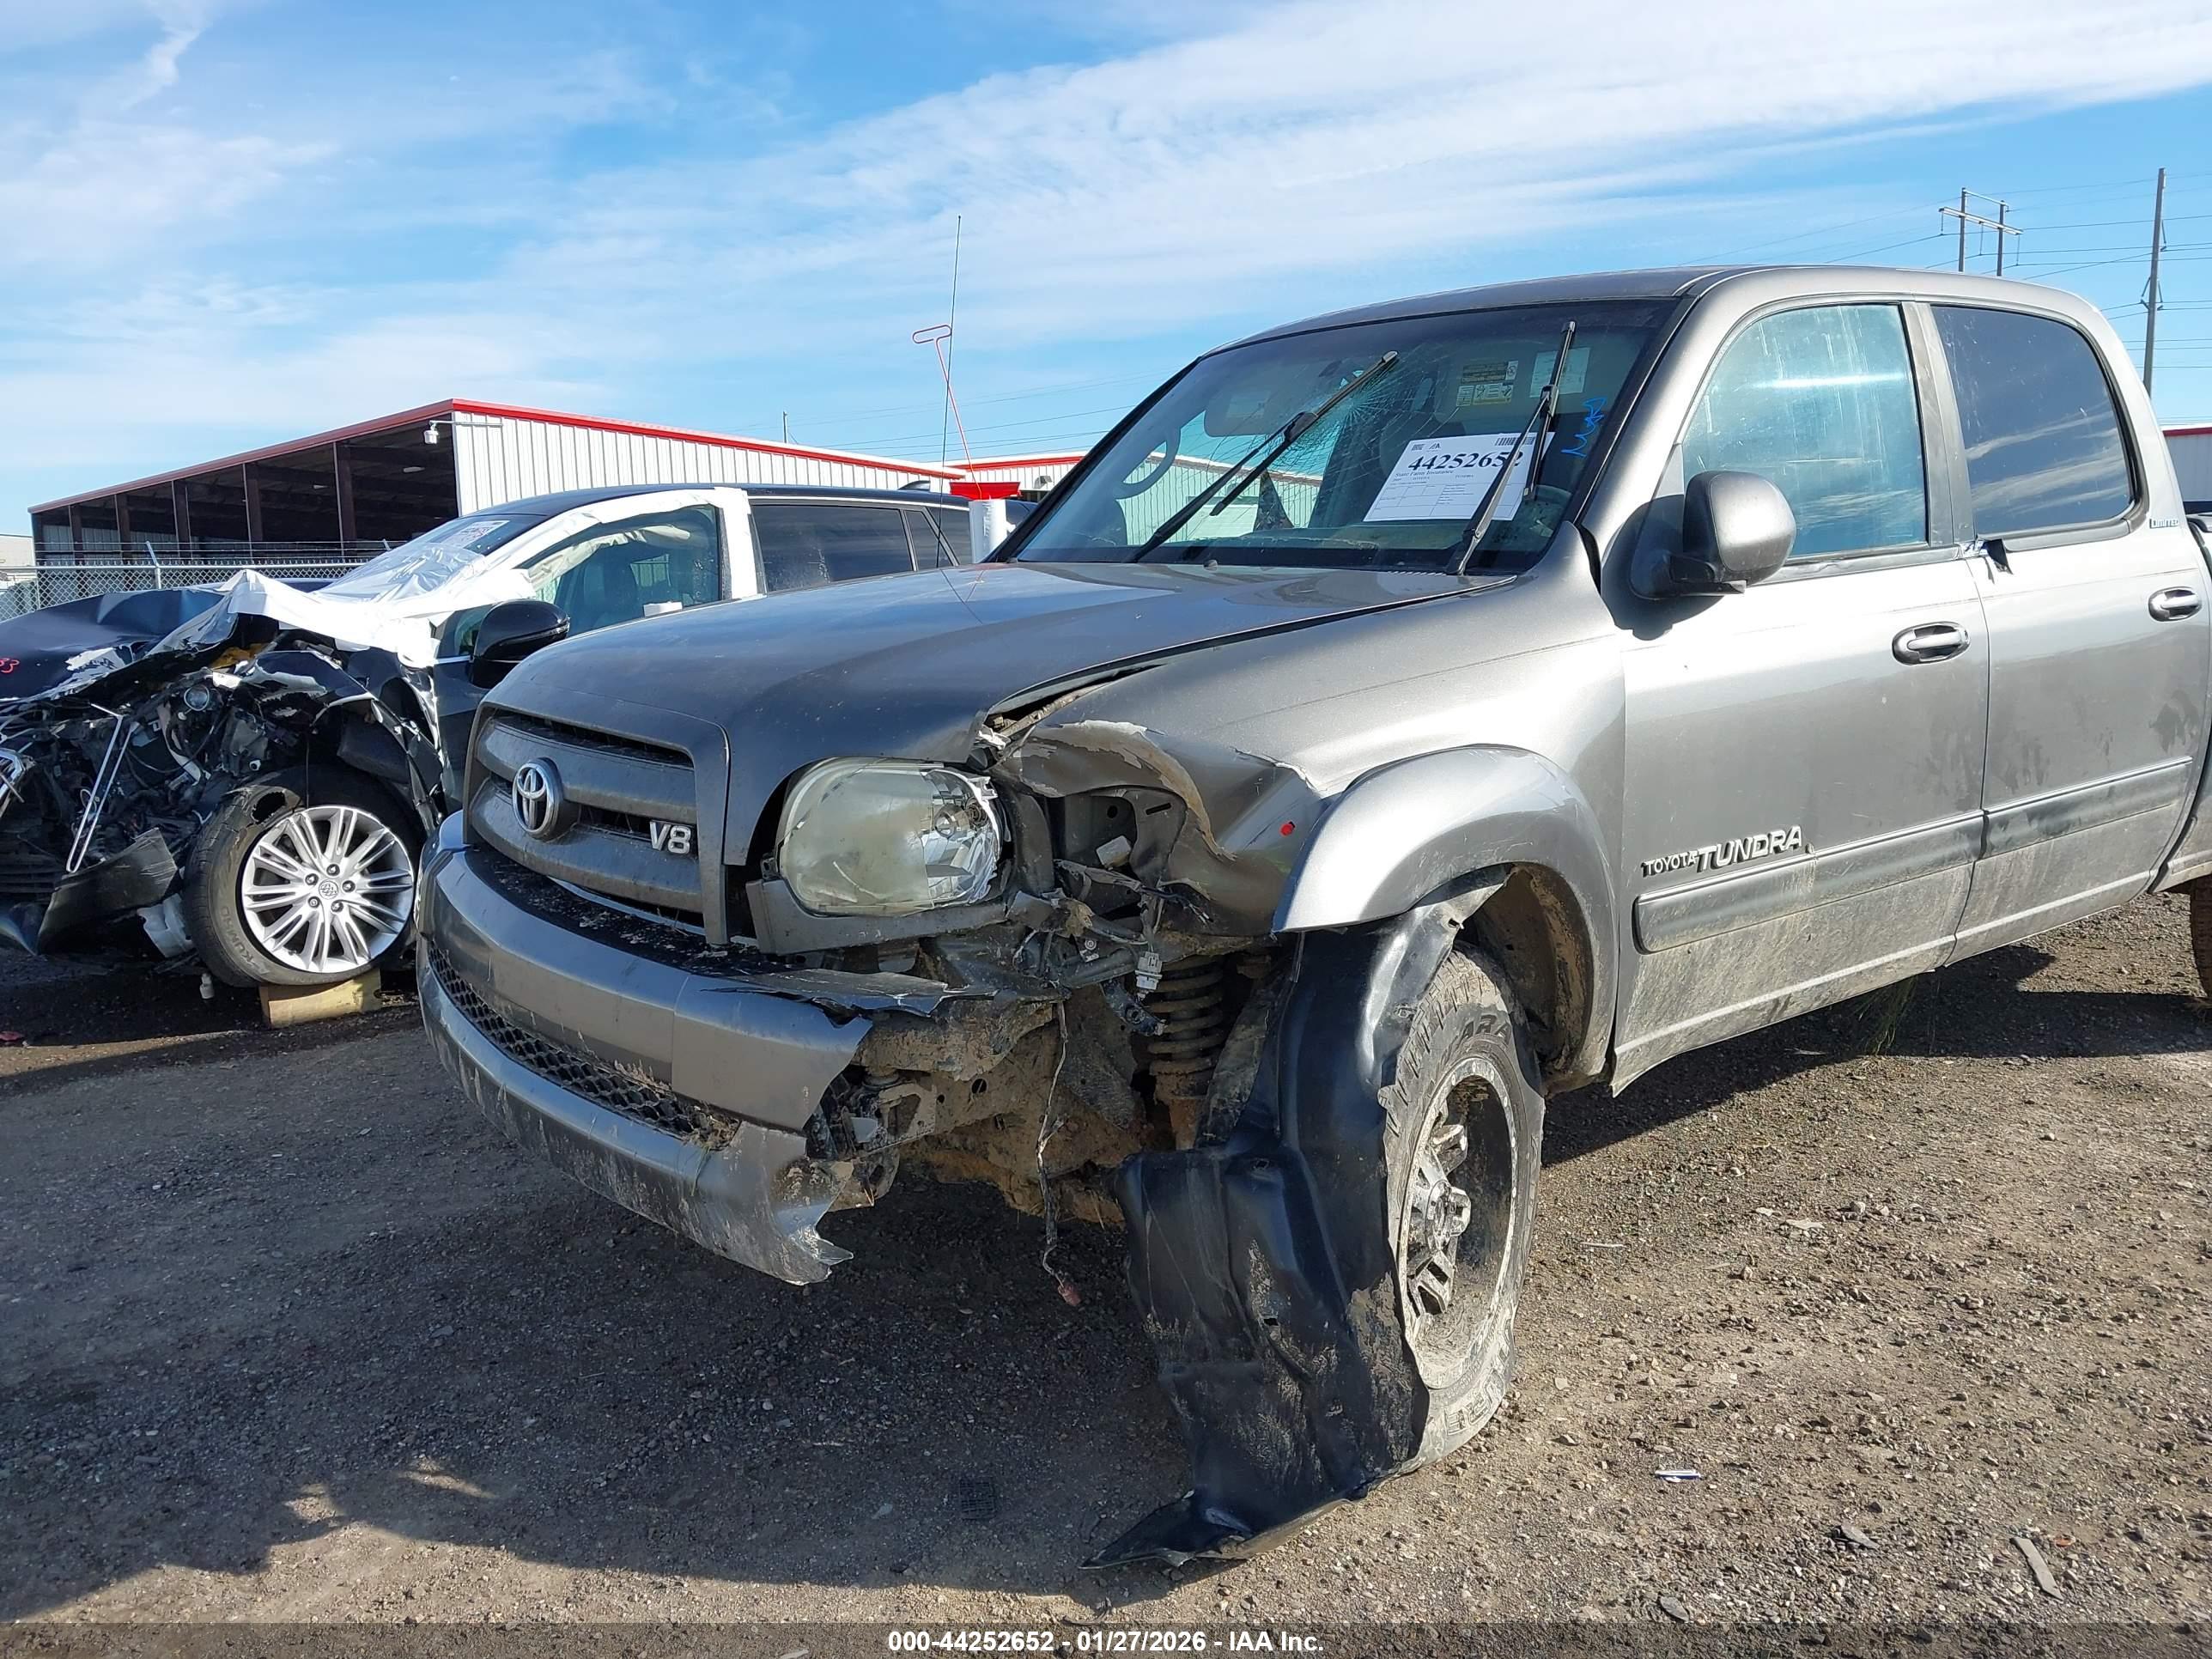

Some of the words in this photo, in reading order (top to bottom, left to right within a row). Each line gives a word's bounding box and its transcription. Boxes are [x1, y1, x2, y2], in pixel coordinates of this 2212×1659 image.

[649, 820, 692, 854] V8
[1641, 850, 1698, 878] TOYOTA
[1696, 825, 1802, 872] TUNDRA
